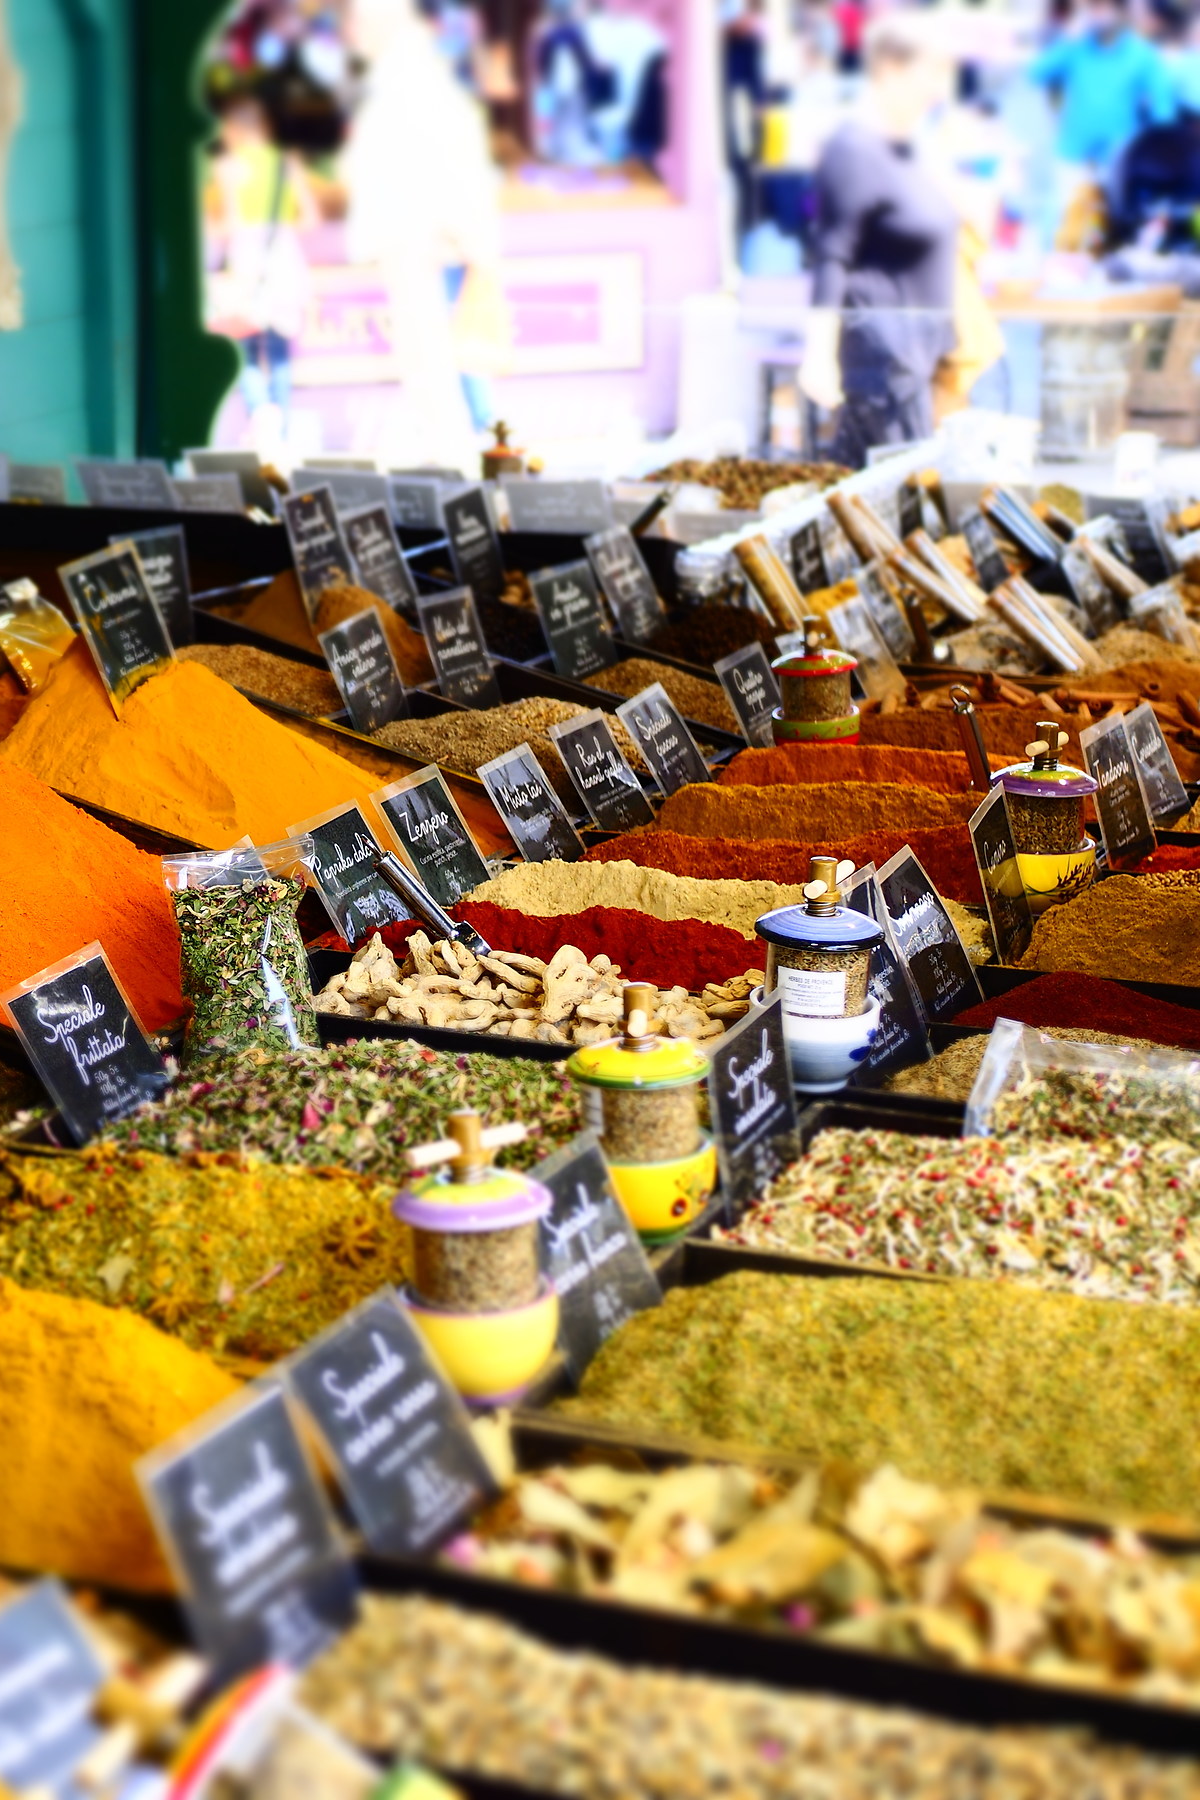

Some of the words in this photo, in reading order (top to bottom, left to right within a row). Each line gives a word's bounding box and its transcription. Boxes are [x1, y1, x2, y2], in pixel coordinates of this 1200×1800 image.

[635, 702, 672, 748] Speciale
[575, 743, 597, 768] Ras
[595, 735, 605, 761] el
[1093, 755, 1129, 789] Tandoori
[498, 783, 529, 813] Misto
[399, 810, 449, 845] Zenzero
[312, 841, 354, 889] Paprika
[353, 832, 375, 866] dolc
[37, 984, 105, 1052] Speciale
[66, 1029, 126, 1086] frittata
[728, 1028, 774, 1109] Speciale
[322, 1331, 406, 1428] Speciale
